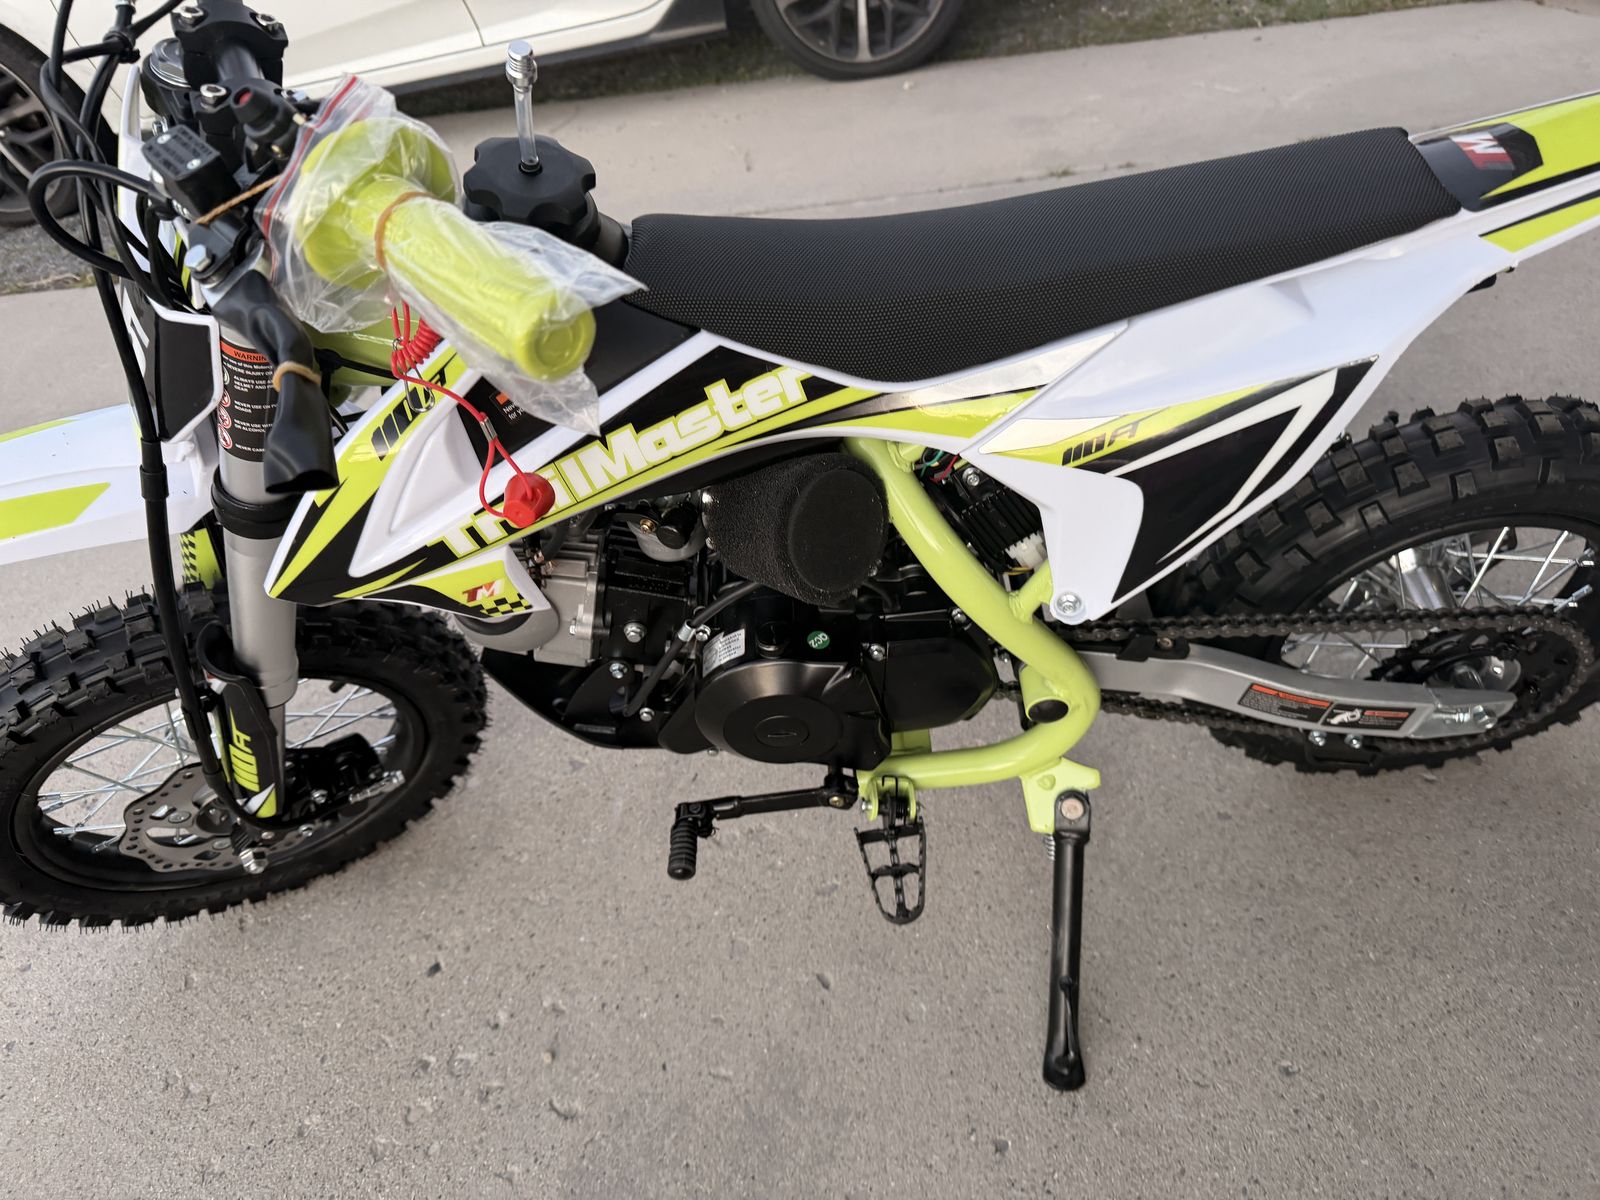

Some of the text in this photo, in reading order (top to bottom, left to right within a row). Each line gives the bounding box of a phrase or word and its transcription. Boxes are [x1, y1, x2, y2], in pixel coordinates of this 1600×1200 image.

[233, 350, 267, 361] WARNIN
[433, 365, 812, 556] TrilMaster
[463, 578, 505, 603] TM
[808, 632, 828, 649] QC2
